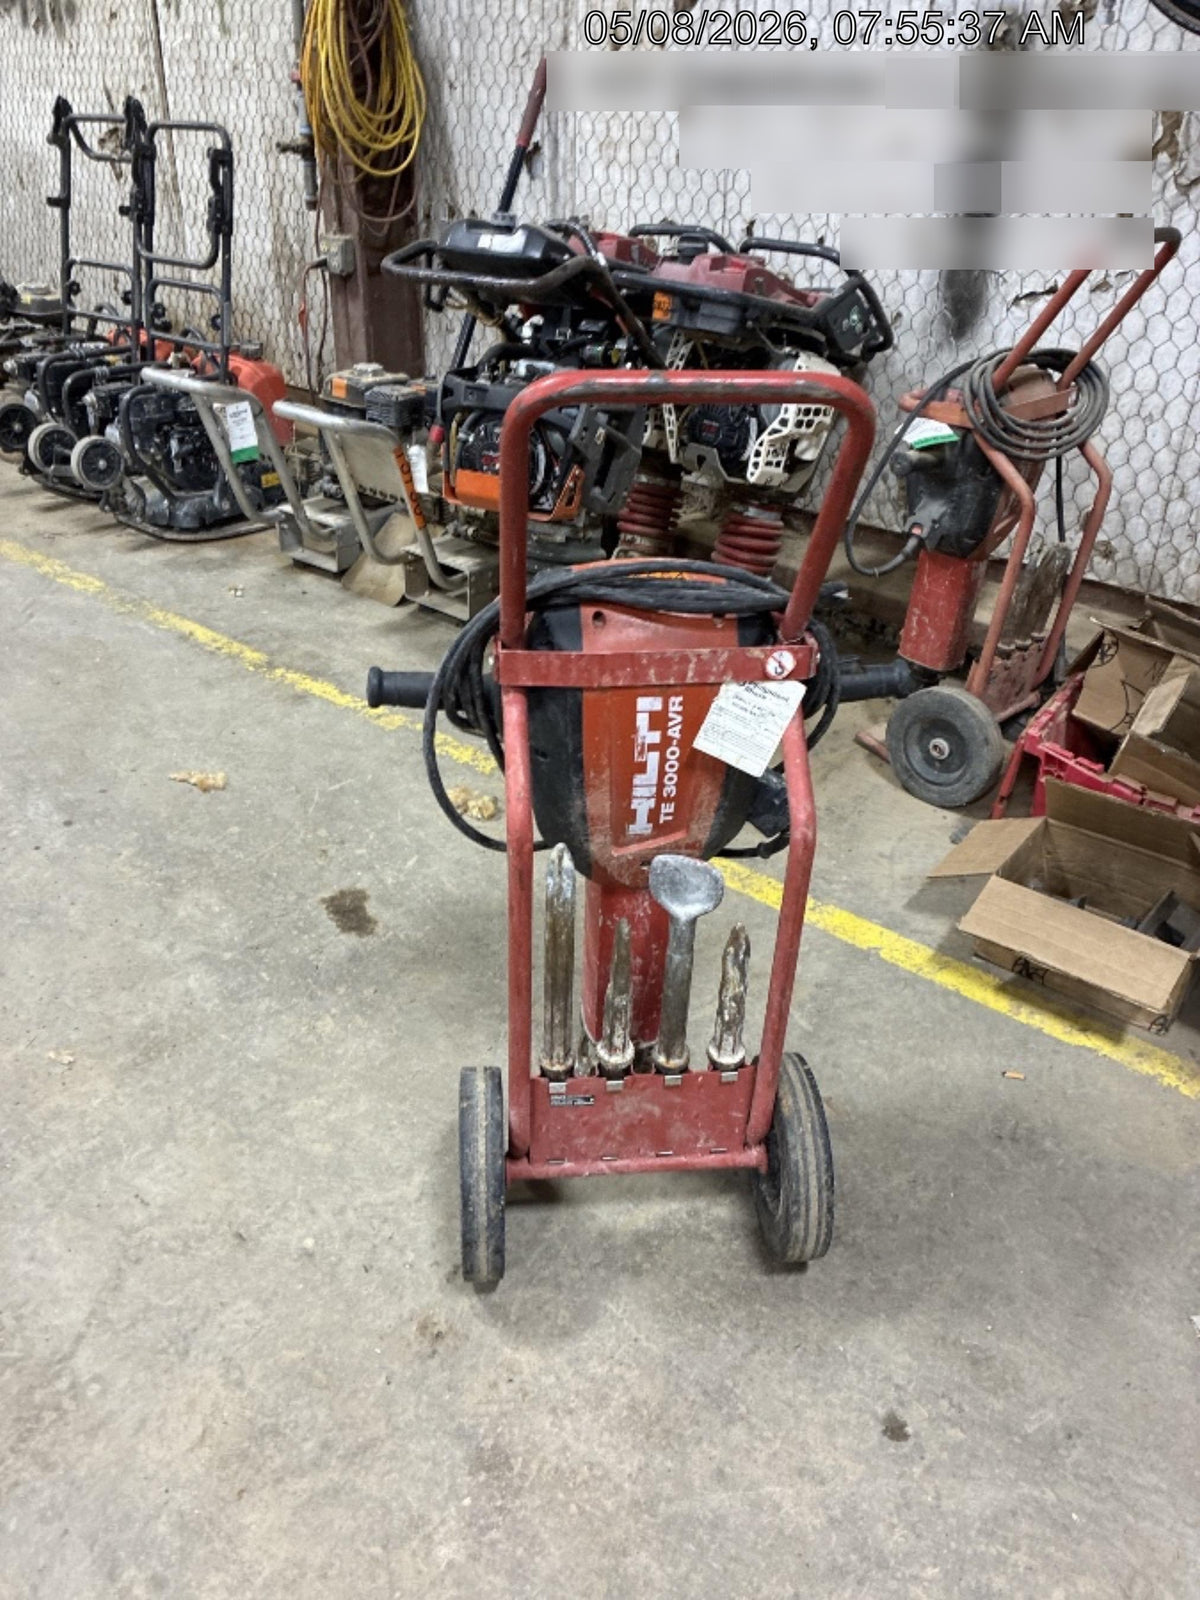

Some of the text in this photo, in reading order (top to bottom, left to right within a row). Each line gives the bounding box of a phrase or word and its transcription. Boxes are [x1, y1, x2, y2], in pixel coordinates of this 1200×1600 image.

[627, 696, 663, 835] HILTI
[659, 695, 684, 824] TE 3000-AVR
